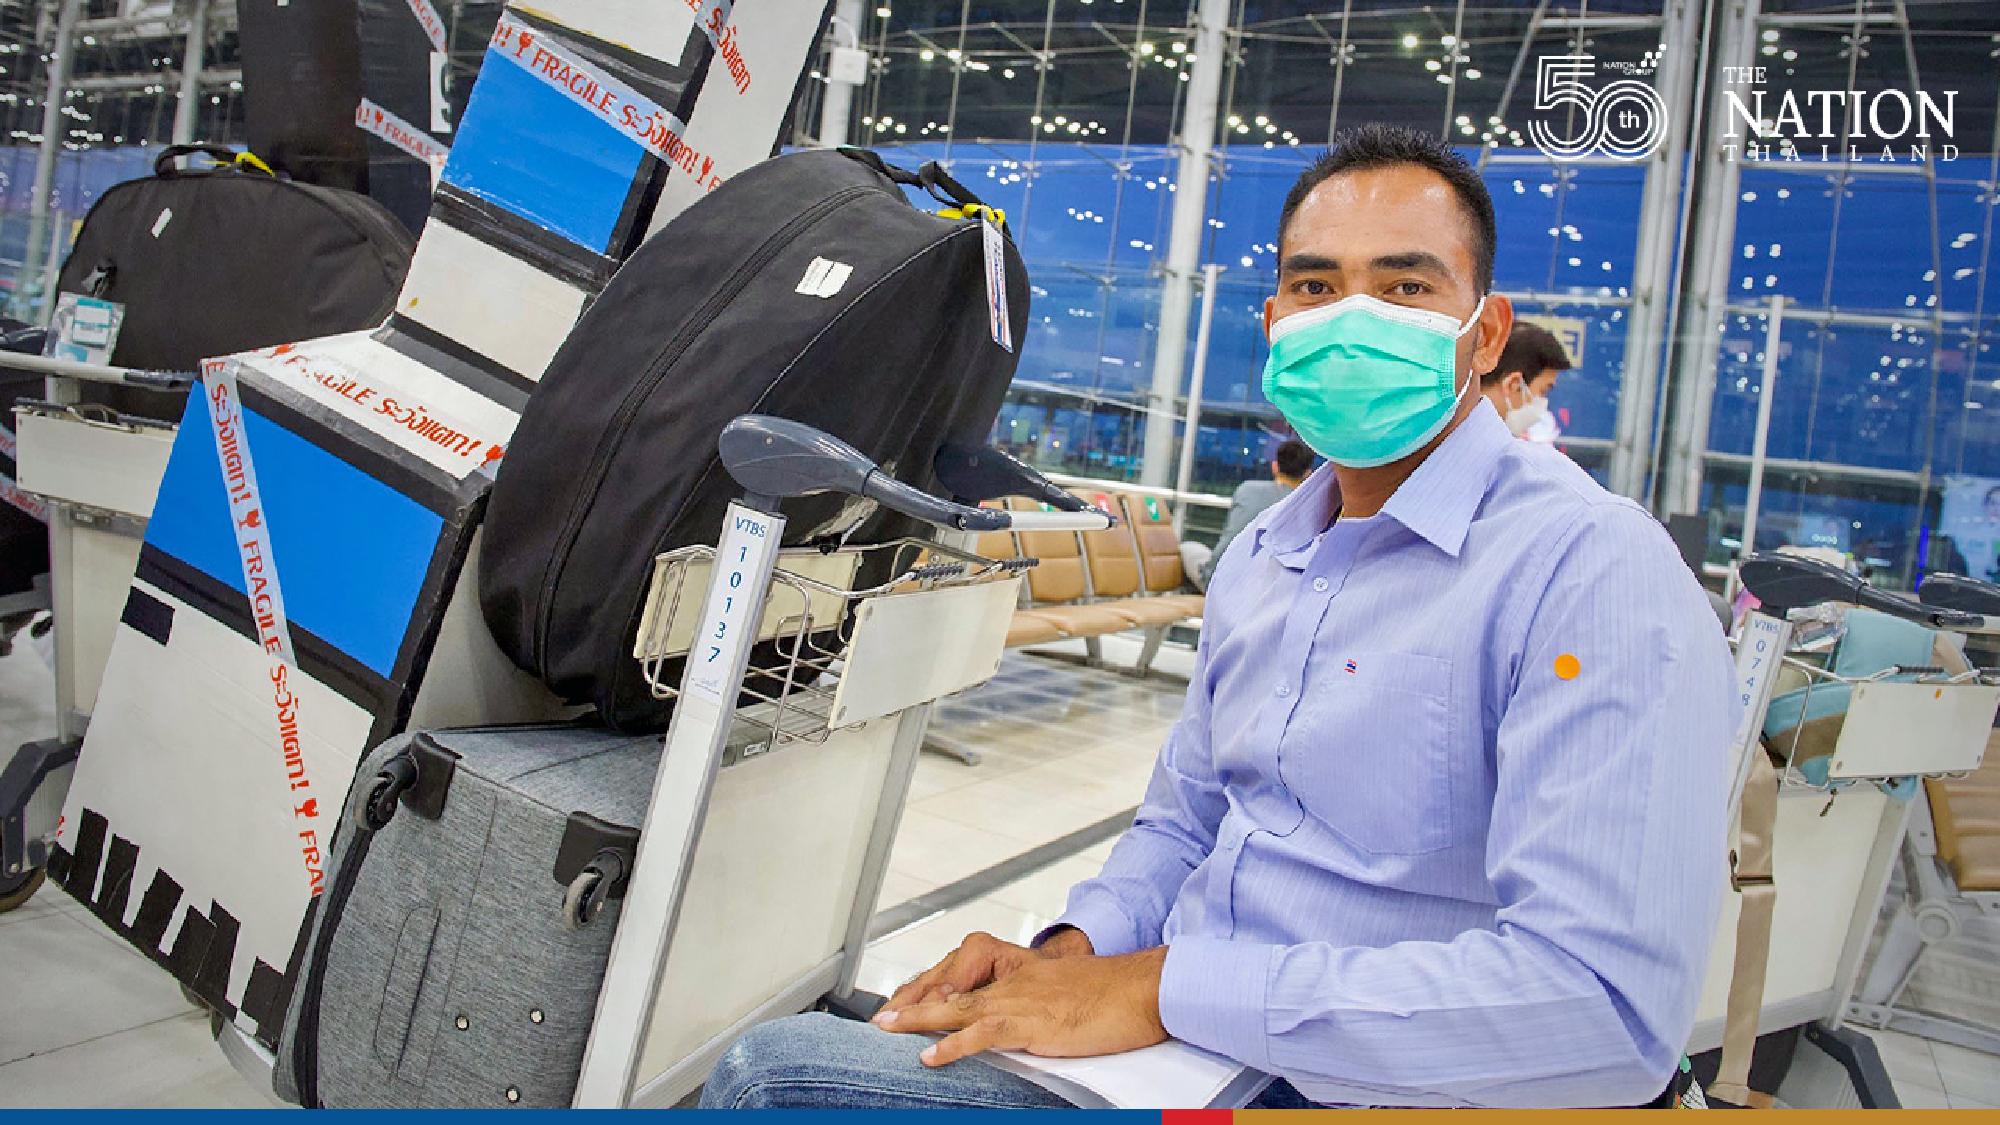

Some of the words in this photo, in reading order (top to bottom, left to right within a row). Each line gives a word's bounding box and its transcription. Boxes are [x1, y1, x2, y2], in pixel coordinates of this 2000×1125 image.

[531, 47, 617, 114] FRAGILE
[736, 516, 766, 538] VTBS
[243, 540, 283, 655] FRAGILE
